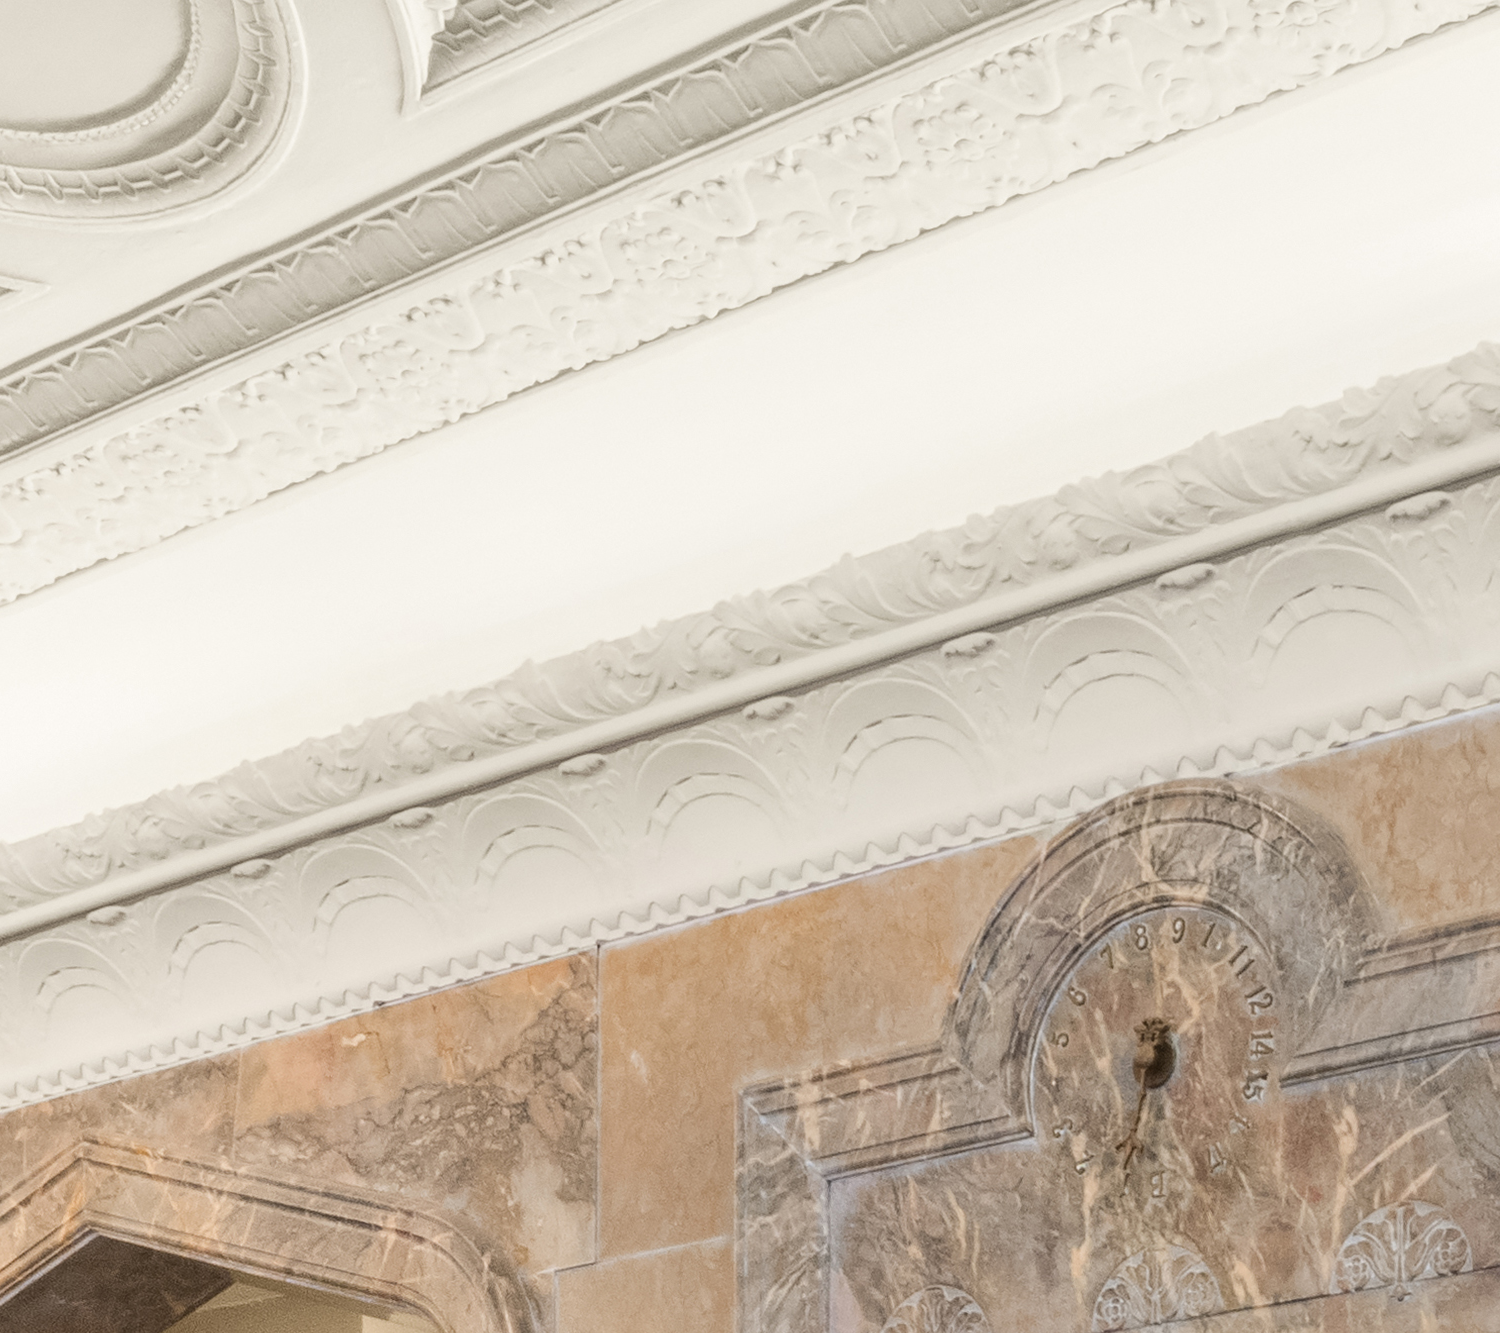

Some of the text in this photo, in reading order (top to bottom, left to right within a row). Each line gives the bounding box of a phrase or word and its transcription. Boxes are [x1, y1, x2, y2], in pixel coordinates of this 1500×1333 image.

[1135, 924, 1149, 951] 8
[1171, 917, 1186, 944] 9
[1100, 942, 1115, 970] 7
[1228, 944, 1256, 979] 11
[1067, 985, 1087, 1007] 6
[1244, 984, 1274, 1015] 12
[1250, 1030, 1275, 1058] 14
[1243, 1069, 1269, 1101] 15
